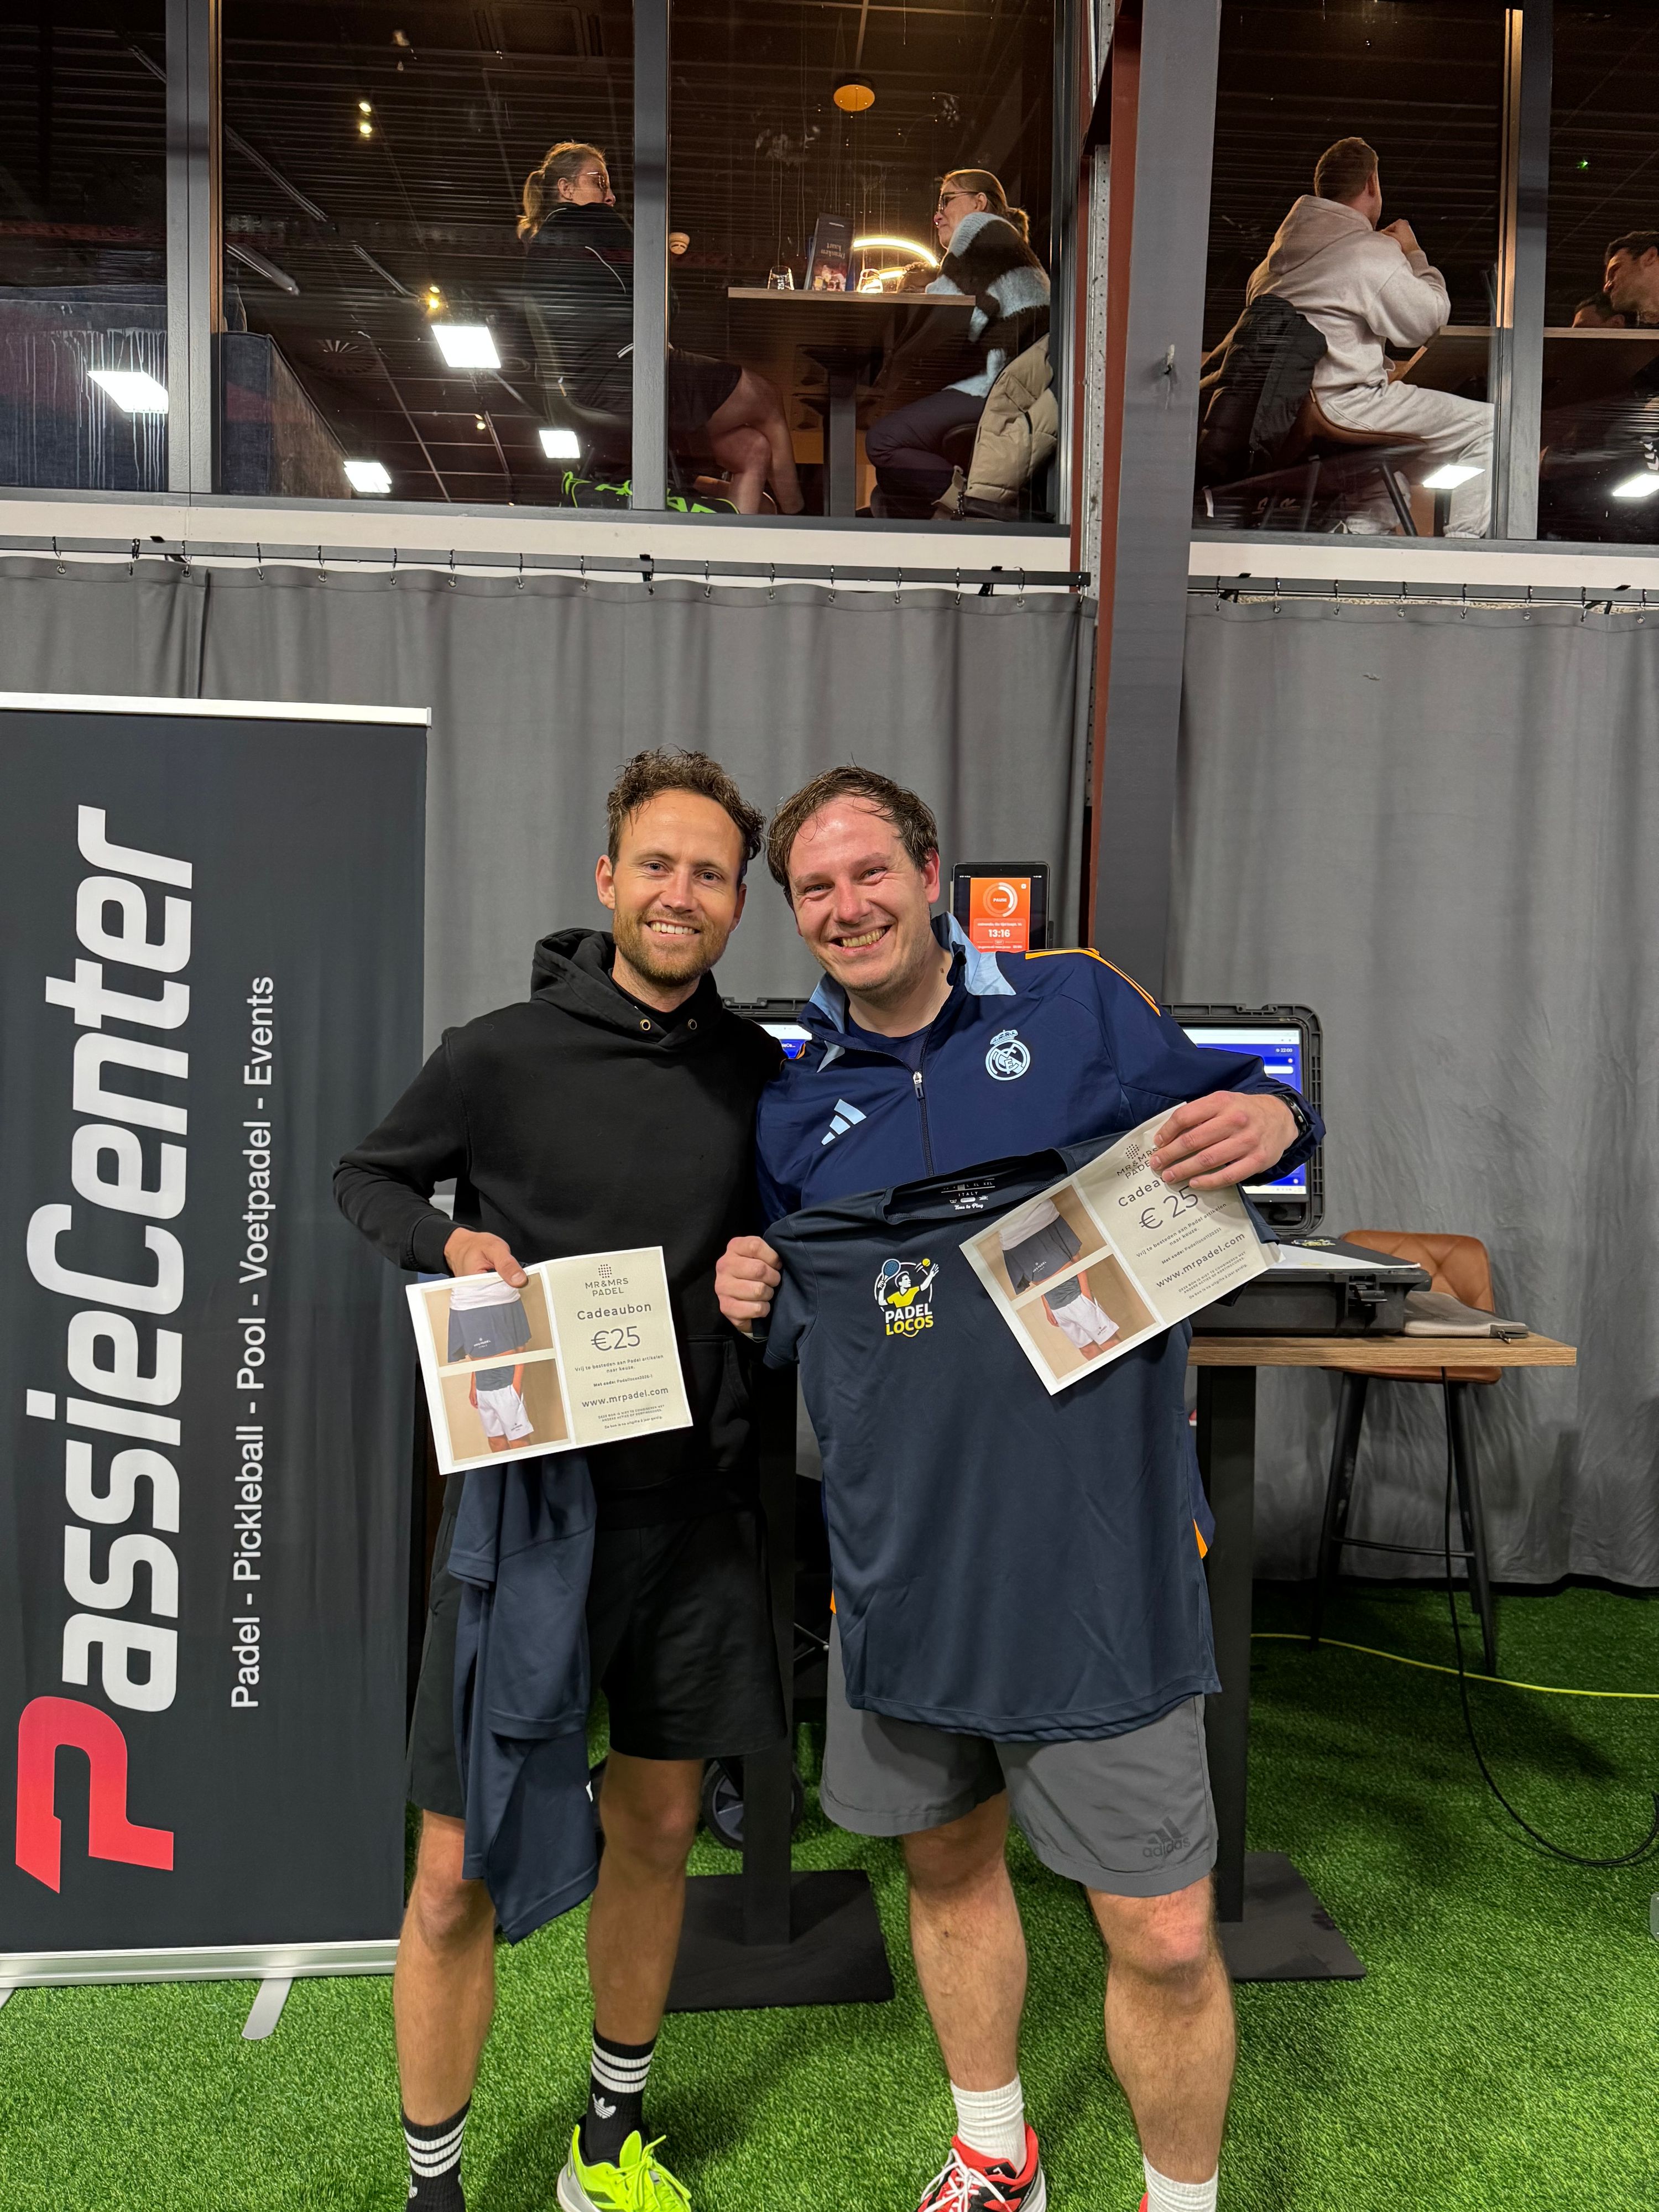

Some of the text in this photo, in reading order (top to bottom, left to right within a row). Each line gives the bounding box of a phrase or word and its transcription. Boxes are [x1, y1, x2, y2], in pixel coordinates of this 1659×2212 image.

[989, 929, 1010, 937] 13:16
[244, 977, 273, 1084] Events
[1125, 1160, 1150, 1178] PADE
[239, 1122, 275, 1283] Voetpadel
[1119, 1177, 1165, 1206] Cadea
[1139, 1186, 1198, 1229] € 25
[1153, 1233, 1177, 1248] besteden
[1188, 1217, 1203, 1227] Padel
[1204, 1203, 1227, 1218] artikelen
[1157, 1234, 1245, 1287] www.mrpadel.com
[585, 1278, 629, 1288] MR&MRS
[593, 1287, 624, 1296] PADEL
[577, 1304, 651, 1319] Cadeaubon
[885, 1303, 932, 1323] PADEL
[886, 1315, 933, 1335] LOCOS
[15, 805, 192, 1893] PassieCenter
[591, 1326, 640, 1351] €25
[237, 1318, 265, 1389] Pool
[582, 1388, 668, 1407] www.mrpadel.com
[233, 1426, 263, 1580] Pickleball
[231, 1618, 260, 1707] Padel
[1142, 1837, 1190, 1858] adidas
